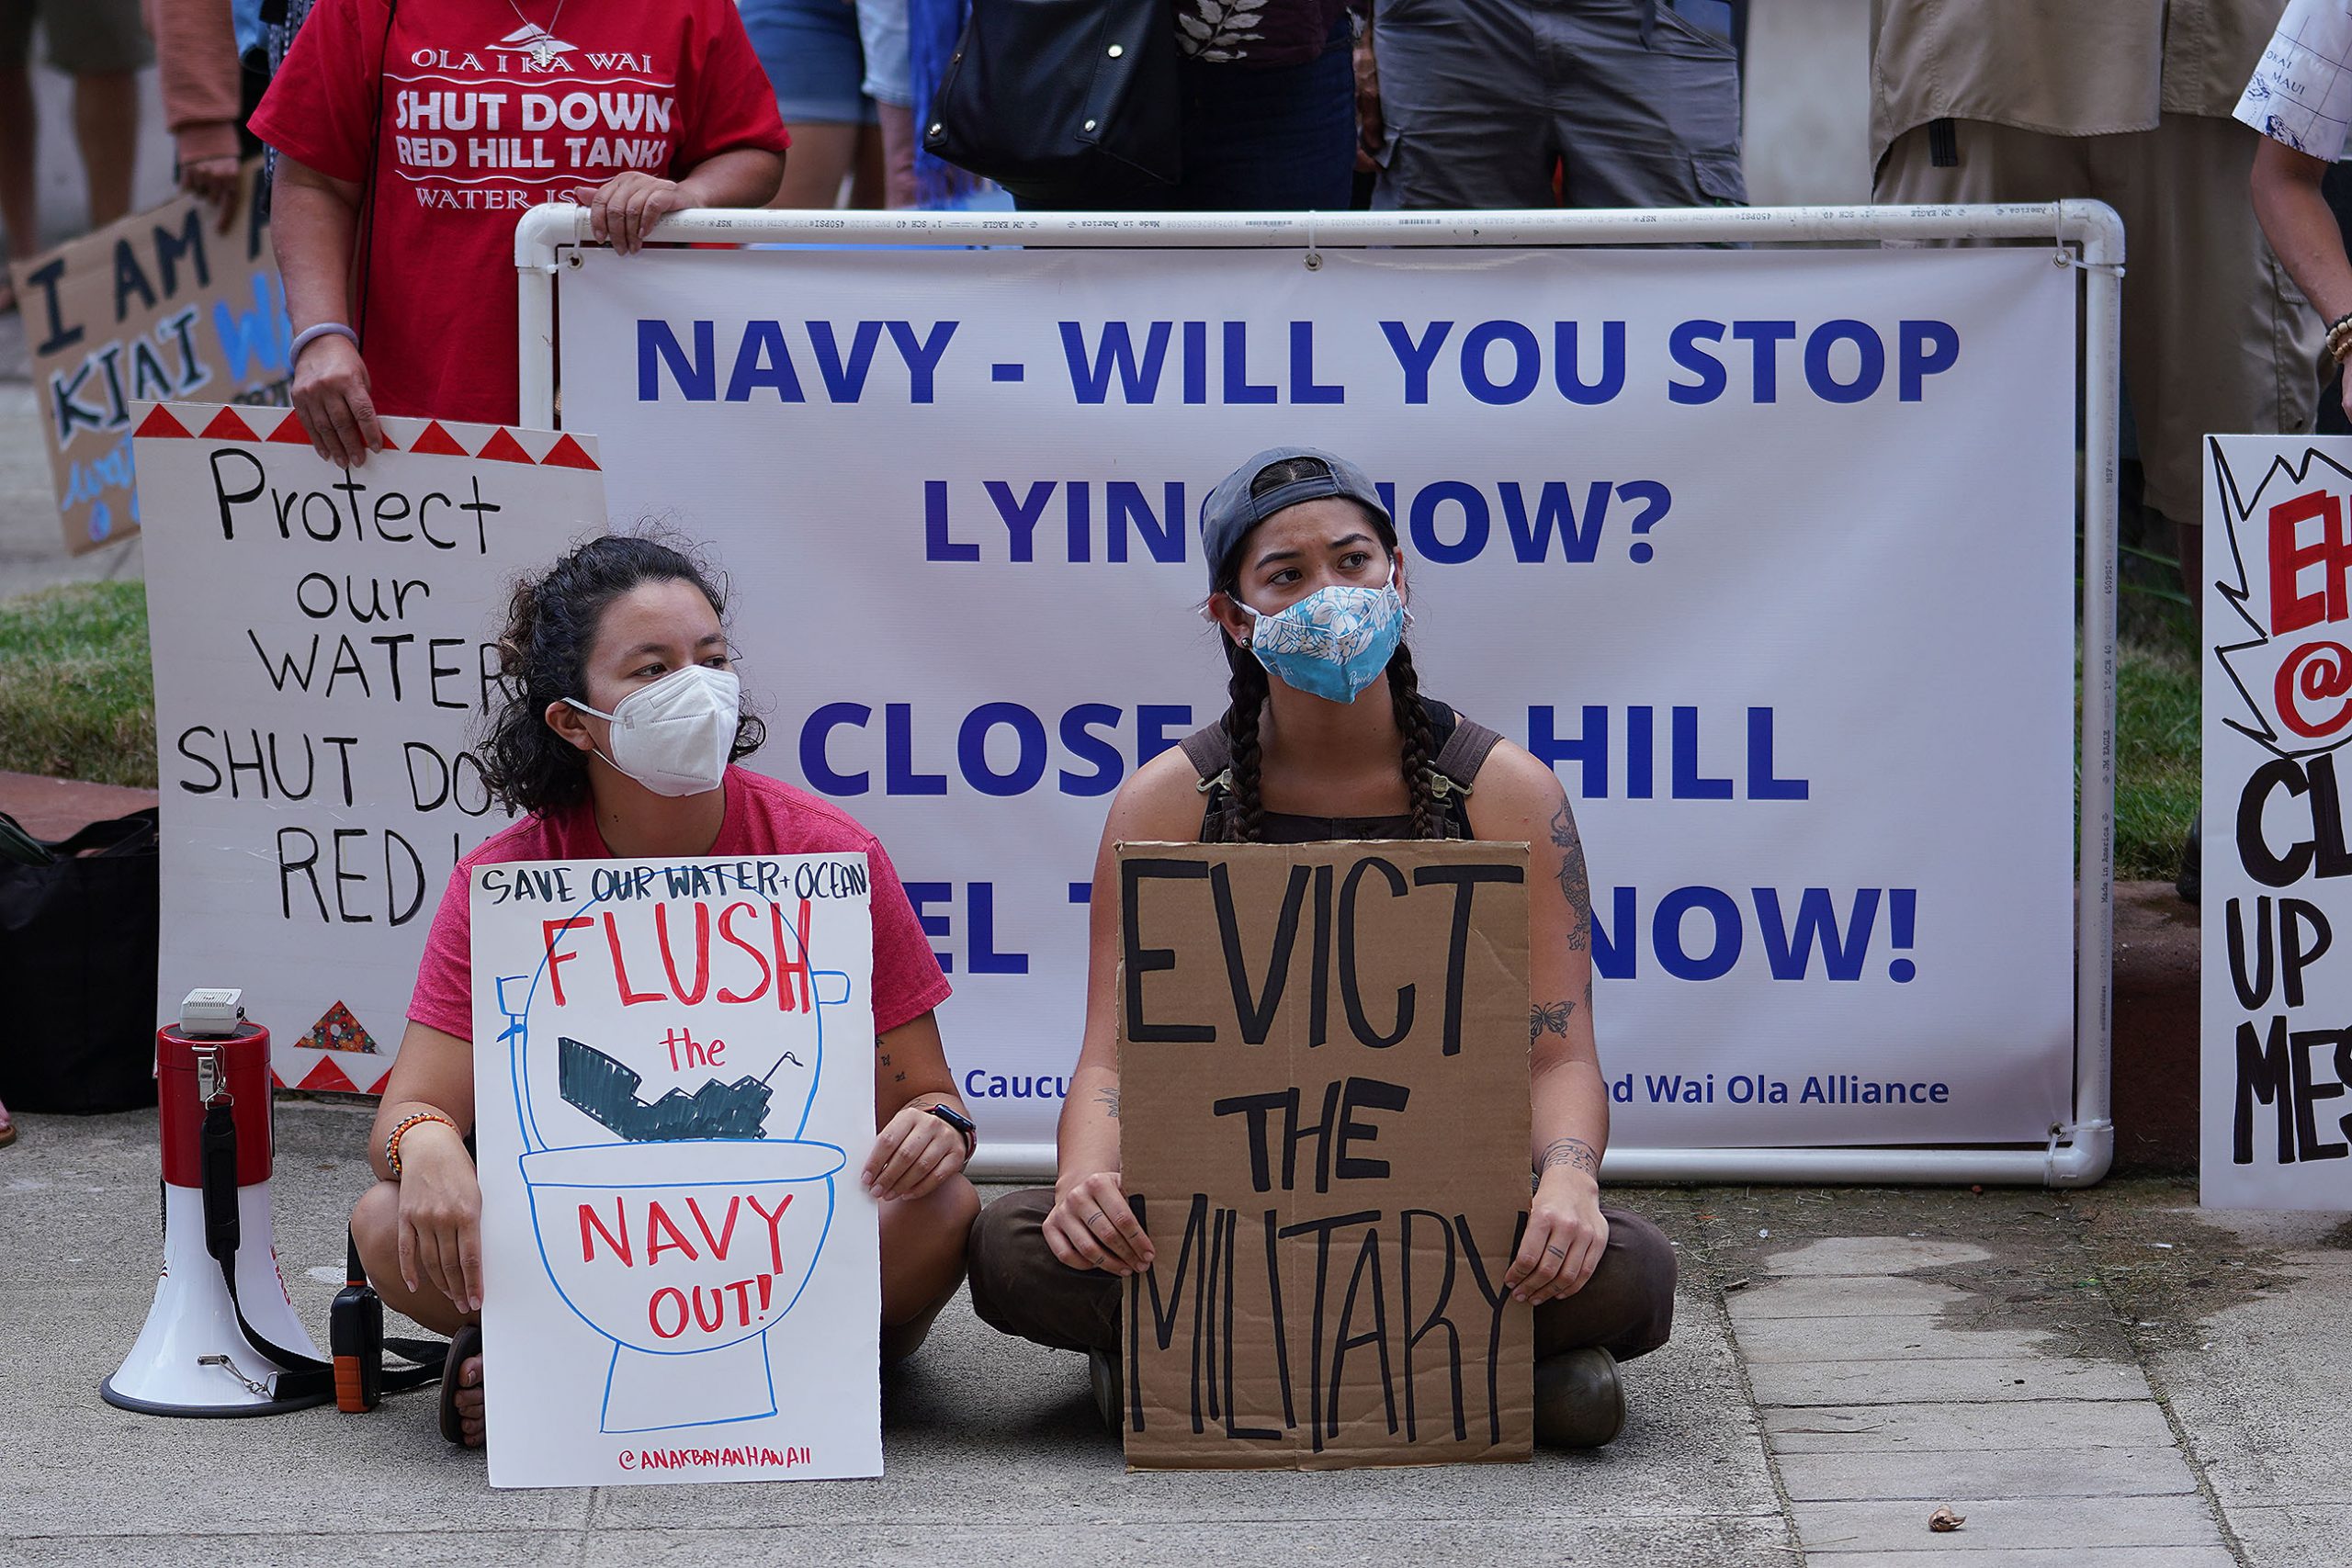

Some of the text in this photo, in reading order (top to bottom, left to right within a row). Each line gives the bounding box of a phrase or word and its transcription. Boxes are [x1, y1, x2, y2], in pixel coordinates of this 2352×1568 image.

[412, 49, 484, 72] OLA
[496, 54, 508, 73] I
[584, 52, 652, 74] WAI
[2272, 72, 2305, 95] MAUI
[396, 90, 674, 132] SHUT DOWN
[396, 136, 667, 168] RED HILL TANKS
[415, 187, 532, 210] WATER
[896, 220, 907, 229] 40
[910, 220, 927, 229] SCH
[982, 220, 1009, 229] EAGLE
[1081, 220, 1118, 229] America
[1124, 220, 1134, 229] in
[1139, 220, 1159, 229] Made
[26, 258, 85, 358] I
[114, 207, 210, 323] AM
[637, 319, 1960, 406] NAVY - WILL YOU STOP
[209, 447, 501, 554] Protect
[923, 479, 1207, 563] LYIN
[296, 572, 430, 623] our
[248, 628, 522, 716] WATER
[177, 726, 513, 818] SHUT DO
[1528, 705, 1809, 801] HILL
[277, 827, 426, 928] RED
[482, 866, 576, 905] SAVE
[592, 866, 655, 902] OUR
[664, 861, 779, 898] WATER
[795, 862, 867, 899] OCEAN
[542, 898, 811, 1014] FLUSH
[1122, 856, 1524, 1056] EVICT
[1591, 886, 1917, 984] NOW!
[2225, 895, 2333, 1011] UP
[658, 1027, 727, 1072] the
[1645, 1074, 1714, 1103] Wai
[1726, 1074, 1794, 1104] Ola
[1799, 1074, 1950, 1104] Alliance
[1213, 1076, 1410, 1193] THE
[579, 1193, 795, 1276] NAVY
[648, 1274, 774, 1339] OUT!
[1128, 1193, 1529, 1453] MILITARY
